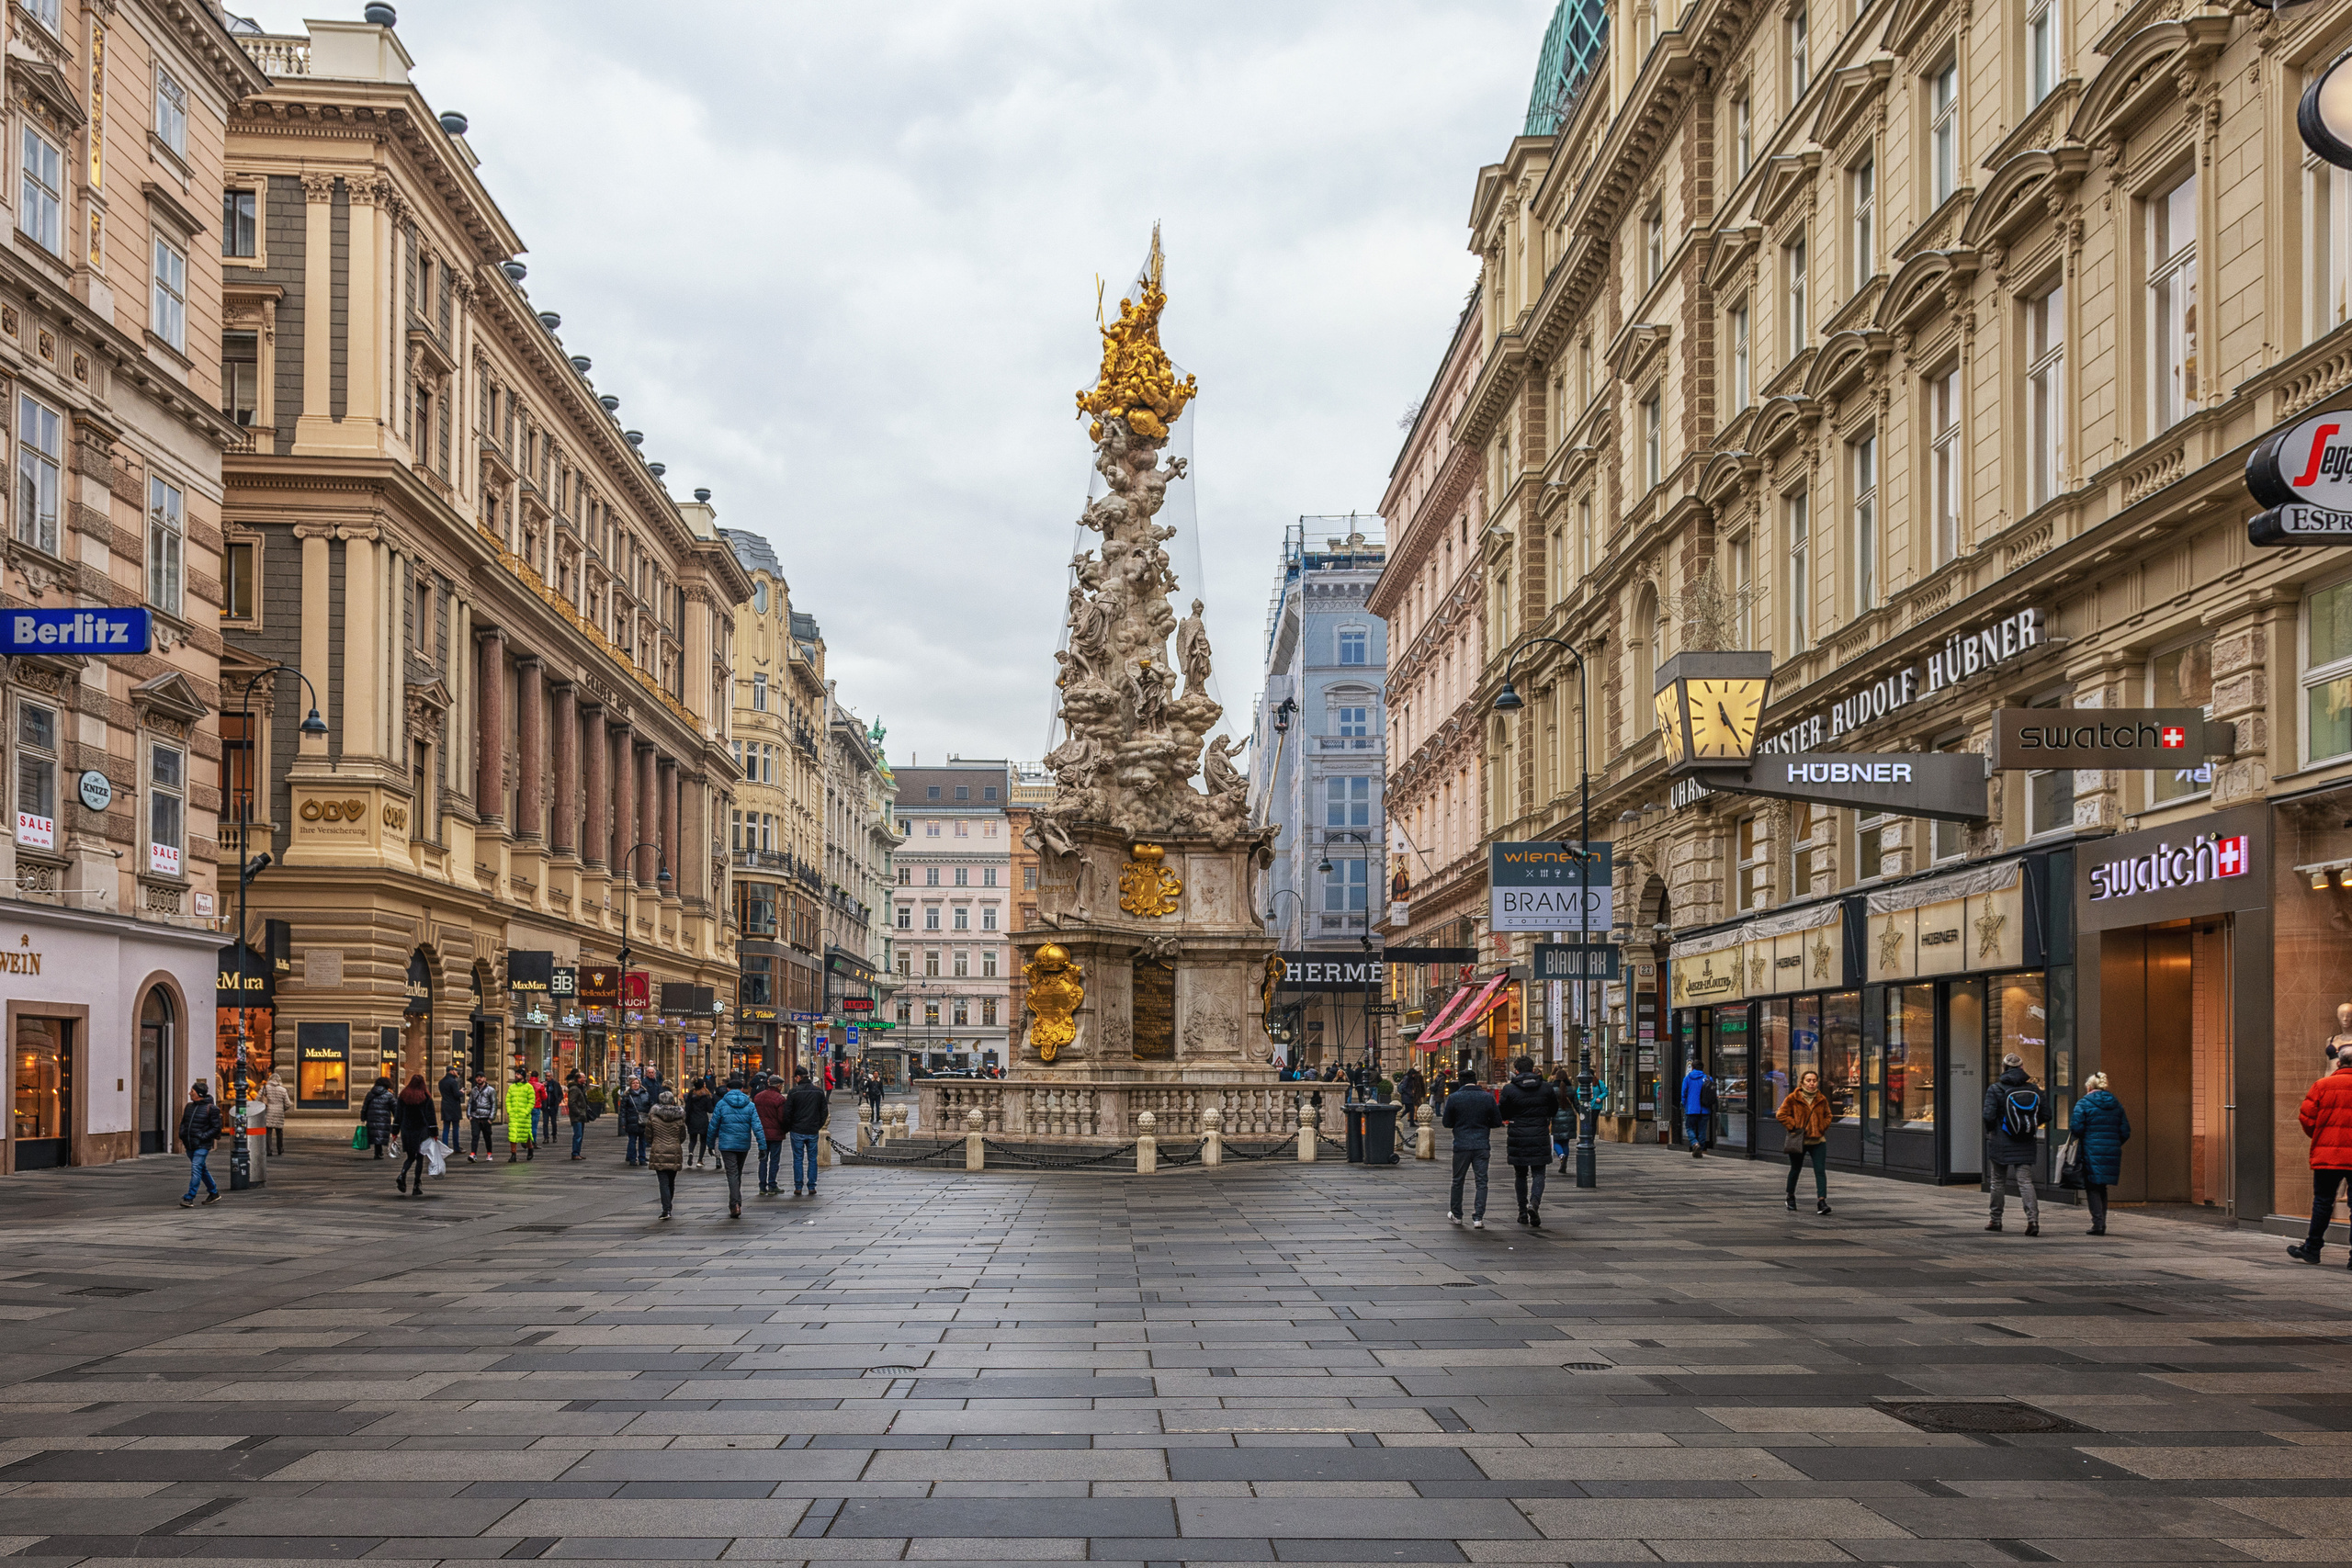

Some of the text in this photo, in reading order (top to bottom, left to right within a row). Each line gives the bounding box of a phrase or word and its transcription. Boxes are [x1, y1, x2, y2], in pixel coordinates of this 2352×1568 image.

[14, 614, 129, 644] Berlitz
[1831, 667, 1917, 738] RUDOLF
[1928, 608, 2039, 693] HÜBNER
[2019, 722, 2158, 749] swatch
[1787, 762, 1911, 783] HÜBNER
[83, 784, 108, 797] KNIZE
[19, 815, 51, 832] SALE
[318, 827, 367, 836] Versicherung
[153, 845, 178, 861] SALE
[2088, 835, 2219, 901] swatch
[1504, 892, 1600, 912] BRAMO
[1284, 961, 1383, 982] HERMÈ
[512, 980, 548, 990] MaxMara
[581, 988, 616, 998] Wellendorff
[754, 1010, 776, 1019] Tchibo
[305, 1048, 342, 1058] MaxMara
